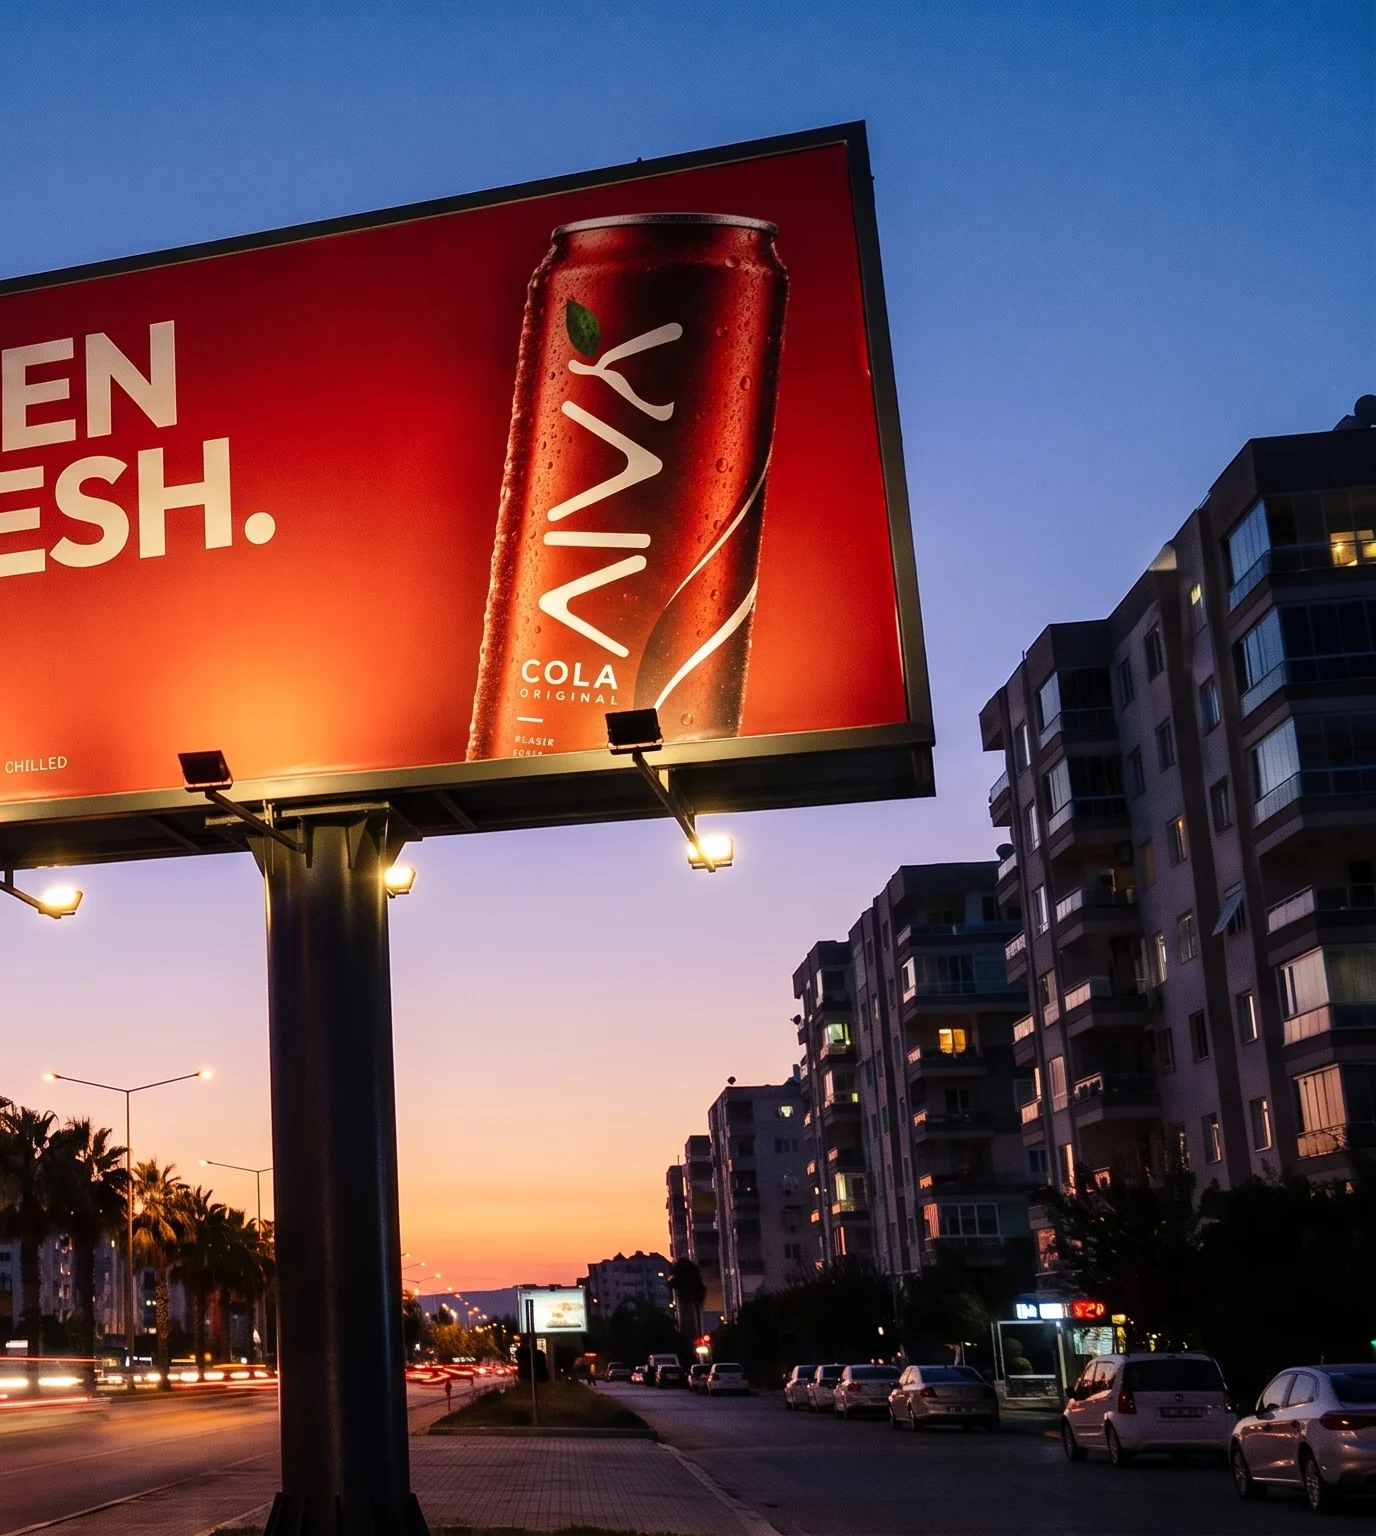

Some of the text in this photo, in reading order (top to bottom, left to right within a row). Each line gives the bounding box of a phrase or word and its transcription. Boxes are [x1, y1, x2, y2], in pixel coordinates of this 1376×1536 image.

[520, 658, 618, 690] COLA
[519, 688, 618, 705] ORIGINAL
[5, 756, 68, 774] CHILLED
